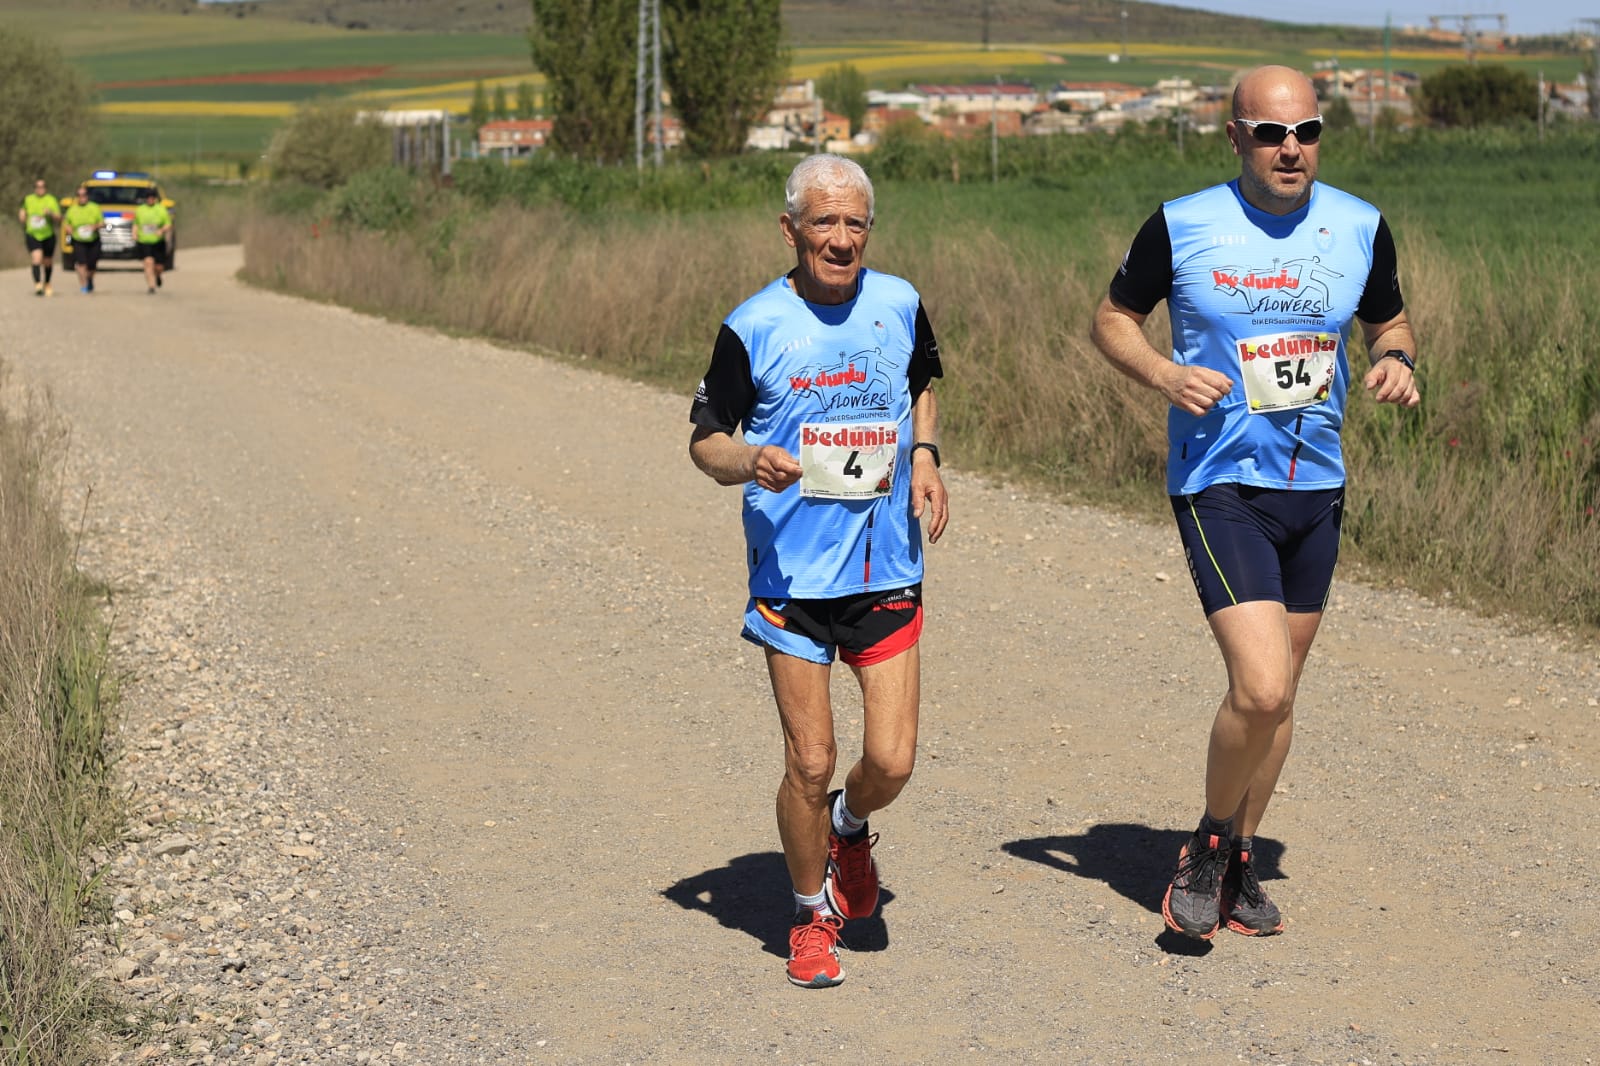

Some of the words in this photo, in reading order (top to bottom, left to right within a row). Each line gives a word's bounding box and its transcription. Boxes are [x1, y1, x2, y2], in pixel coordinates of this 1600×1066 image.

[1257, 296, 1322, 313] FLOWERS
[1240, 336, 1336, 362] bedunia
[1274, 358, 1311, 390] 54
[830, 392, 887, 409] FLOWERS
[802, 426, 897, 447] bedunia
[843, 450, 864, 479] 4
